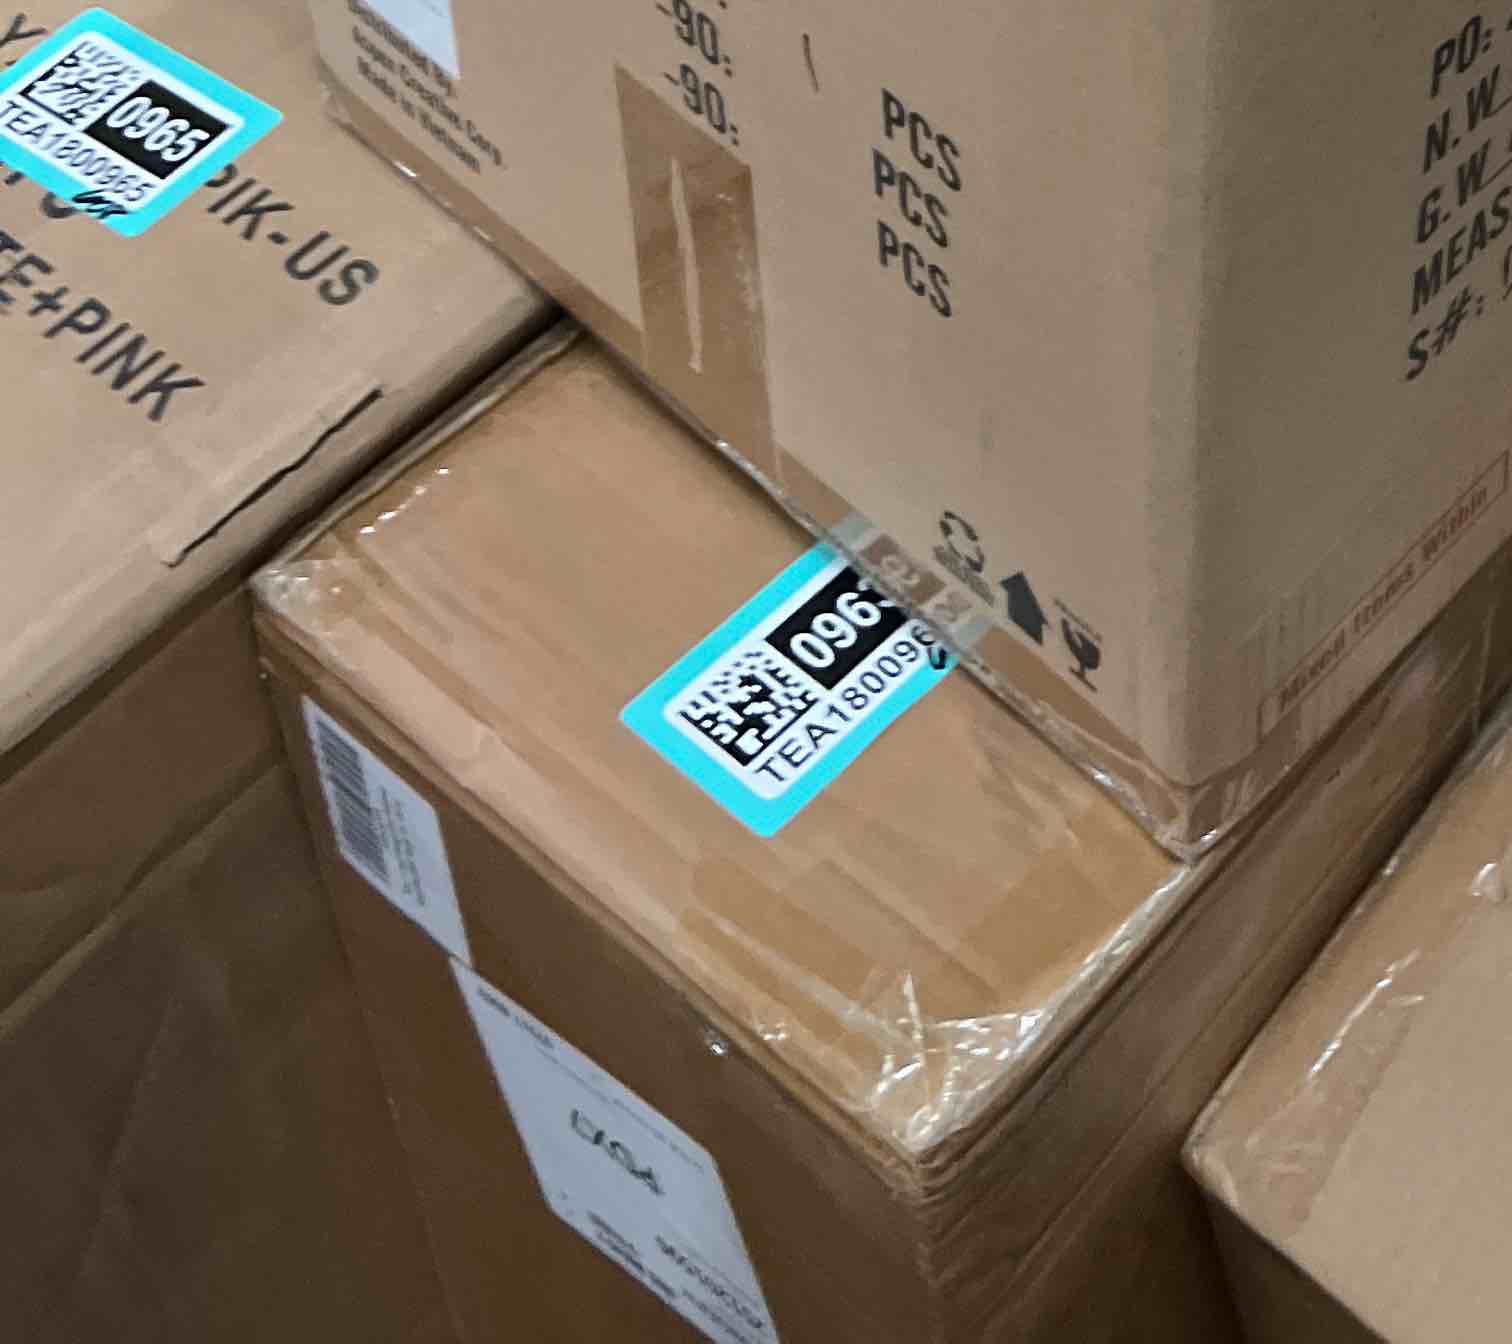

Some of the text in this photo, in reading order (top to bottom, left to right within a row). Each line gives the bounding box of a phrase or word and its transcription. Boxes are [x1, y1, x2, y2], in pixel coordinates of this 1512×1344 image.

[1430, 15, 1494, 99] PO:
[2, 100, 156, 202] TEA1800965
[106, 96, 211, 162] 0965
[882, 87, 961, 192] PCS
[872, 148, 948, 249] PCS
[877, 220, 952, 318] PCS
[789, 575, 897, 668] 096
[753, 623, 936, 782] TEA180096
